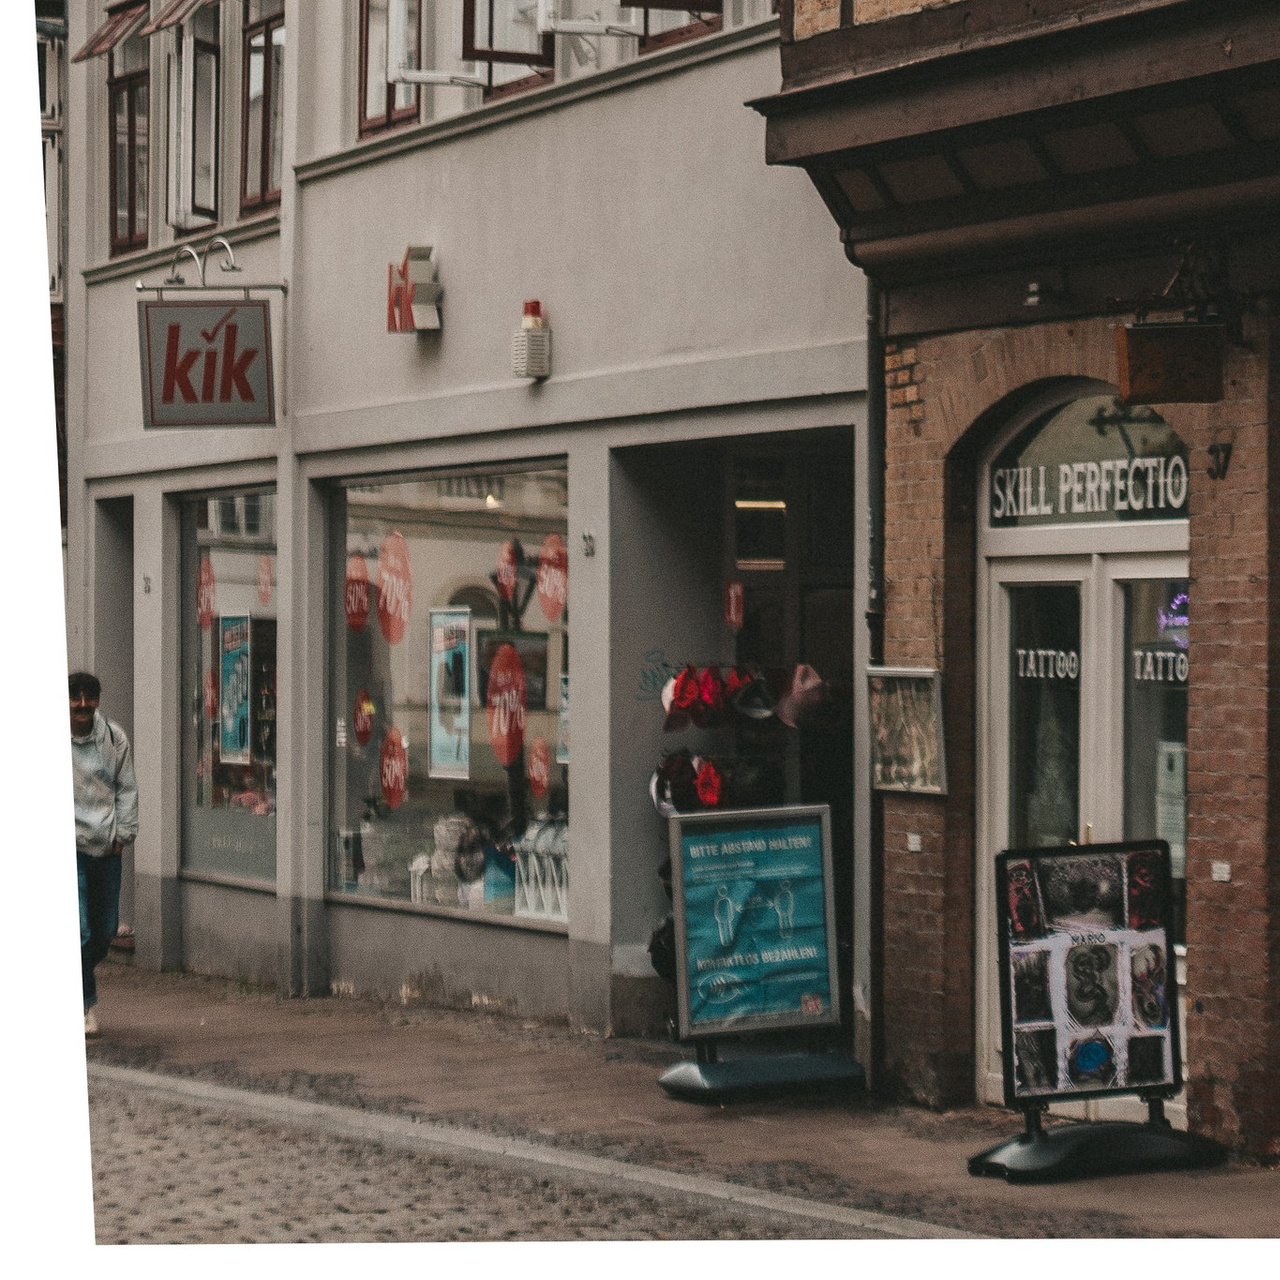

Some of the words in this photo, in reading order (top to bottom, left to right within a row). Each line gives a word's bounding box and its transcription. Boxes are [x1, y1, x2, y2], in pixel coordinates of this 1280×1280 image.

[1206, 442, 1233, 480] 37
[993, 466, 1053, 518] SKILL
[1058, 455, 1188, 514] PERFECTIO
[379, 571, 410, 622] 70%
[1016, 649, 1078, 680] TATTOO
[490, 688, 525, 738] 70%
[689, 843, 719, 859] BITTE
